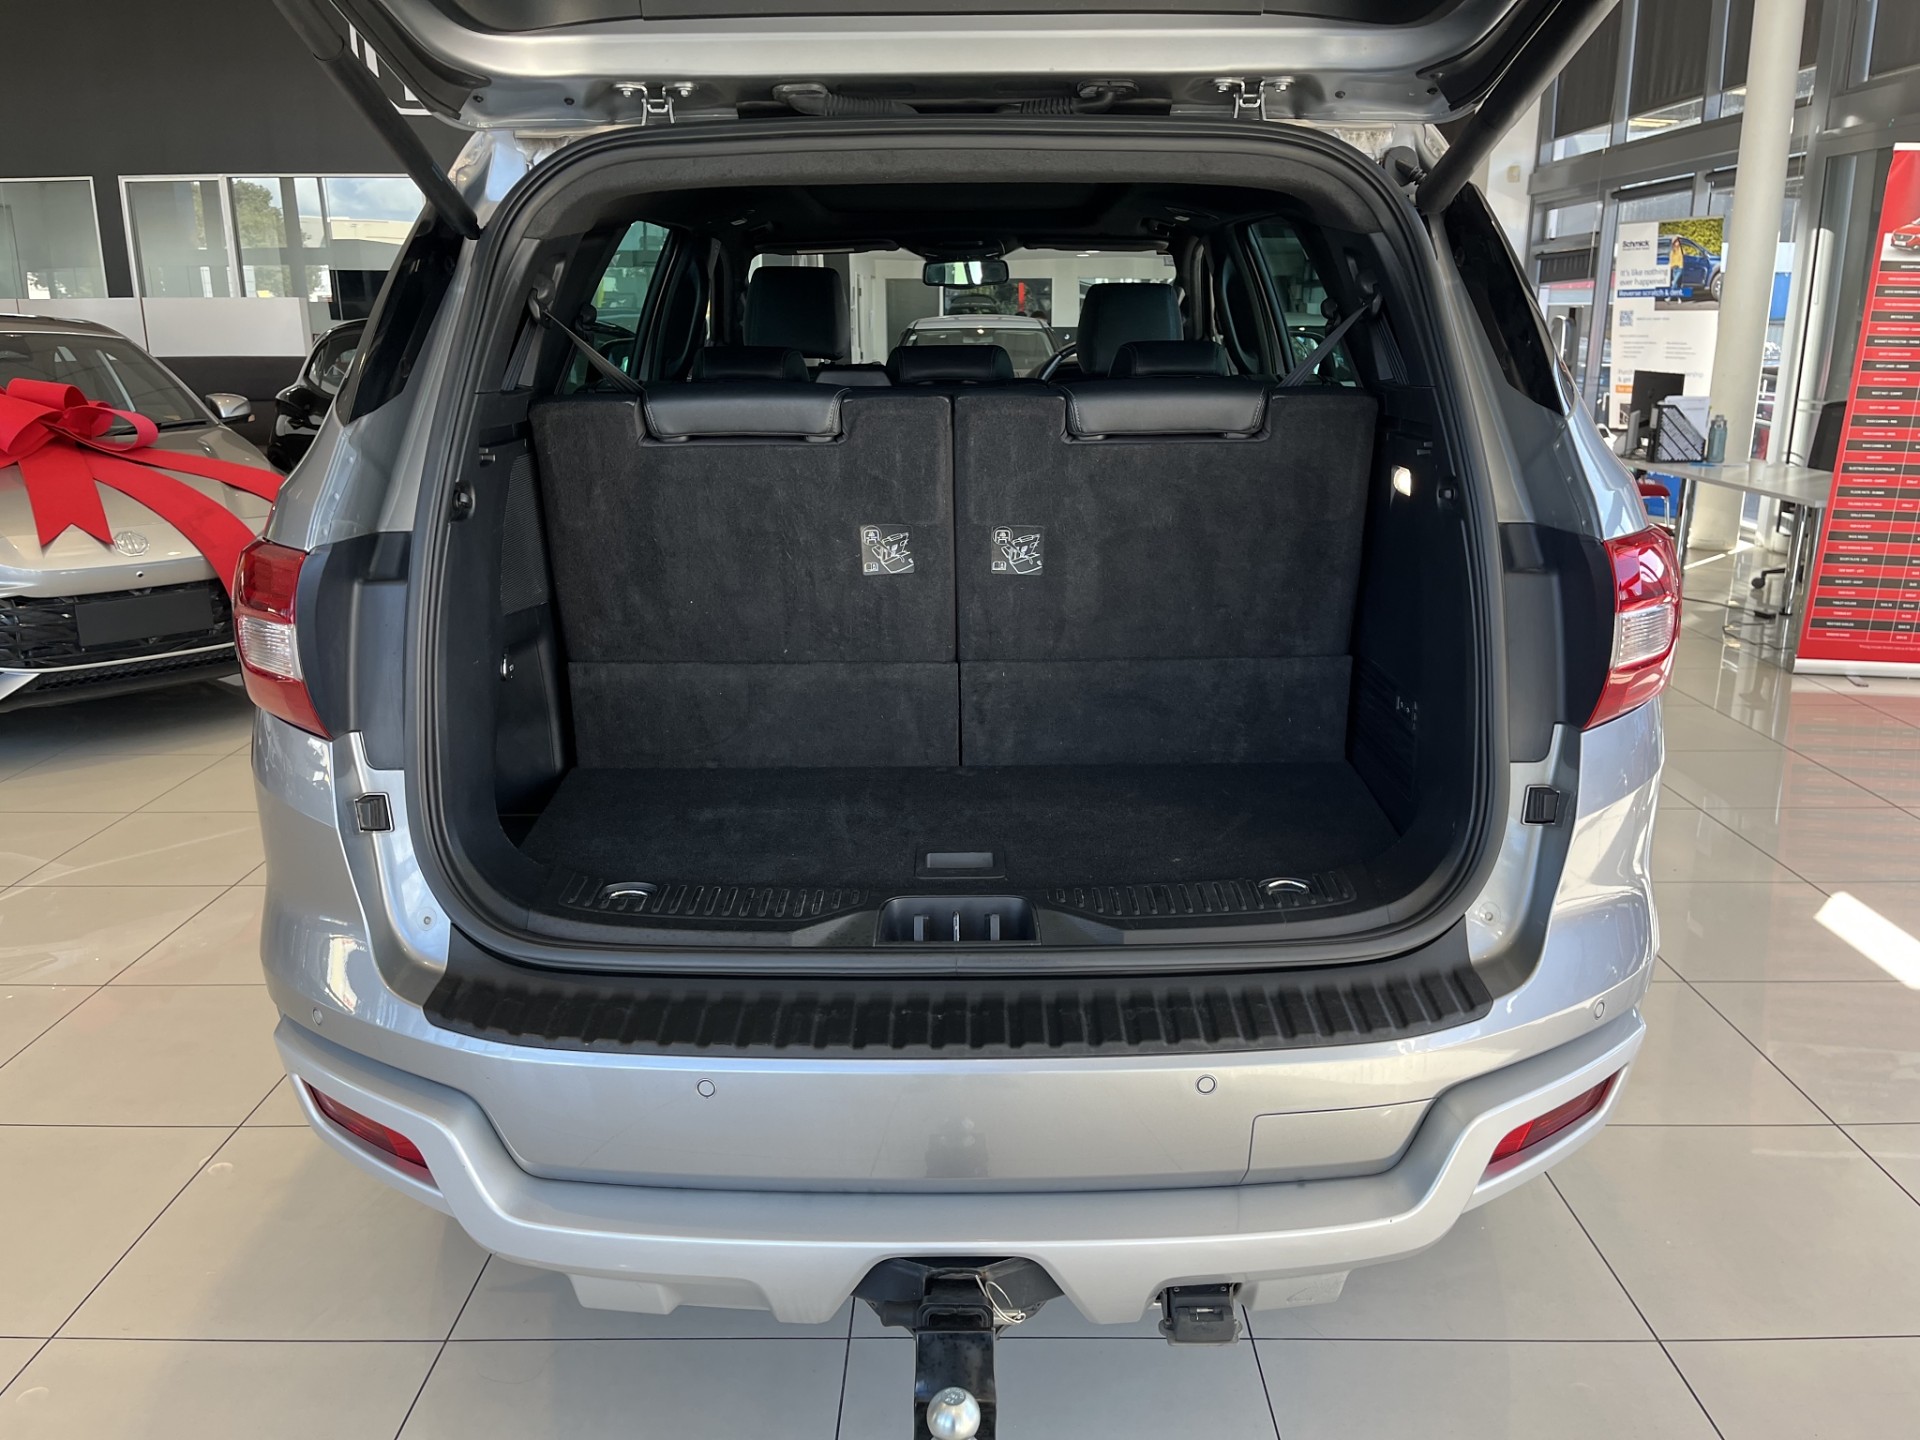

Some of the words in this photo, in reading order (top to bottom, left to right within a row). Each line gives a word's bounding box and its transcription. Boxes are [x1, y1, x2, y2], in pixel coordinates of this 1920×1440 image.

[1622, 240, 1649, 248] Schmick
[1631, 268, 1643, 276] like
[1644, 267, 1668, 277] nothing
[1618, 289, 1641, 297] Reverse
[1642, 289, 1664, 297] scratch
